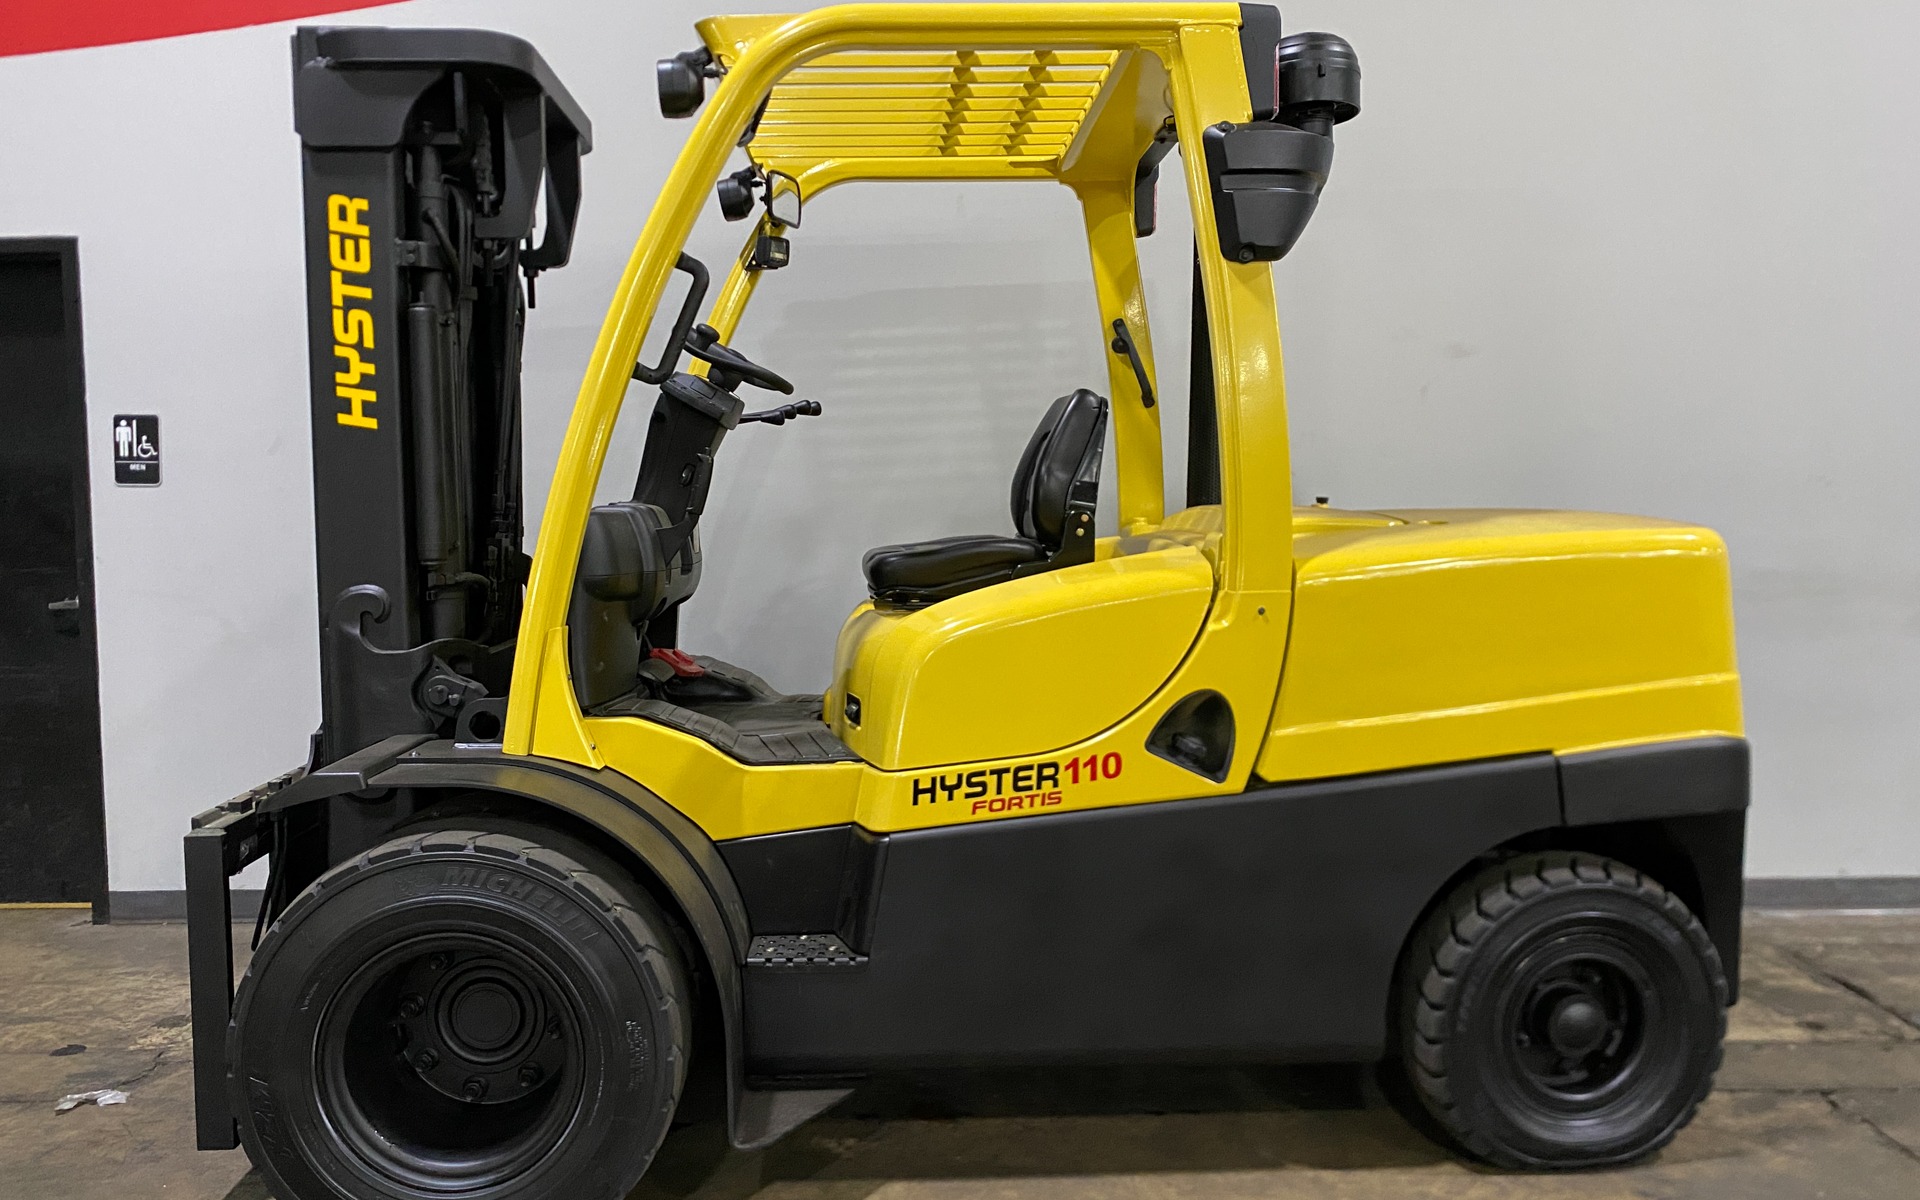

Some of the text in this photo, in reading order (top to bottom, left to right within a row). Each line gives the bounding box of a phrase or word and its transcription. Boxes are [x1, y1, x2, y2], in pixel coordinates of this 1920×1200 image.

[327, 193, 378, 429] HYSTER
[129, 463, 146, 471] MEN
[912, 751, 1123, 806] HYSTER 110
[971, 790, 1063, 816] FORTIS
[440, 866, 599, 941] MICHELIN
